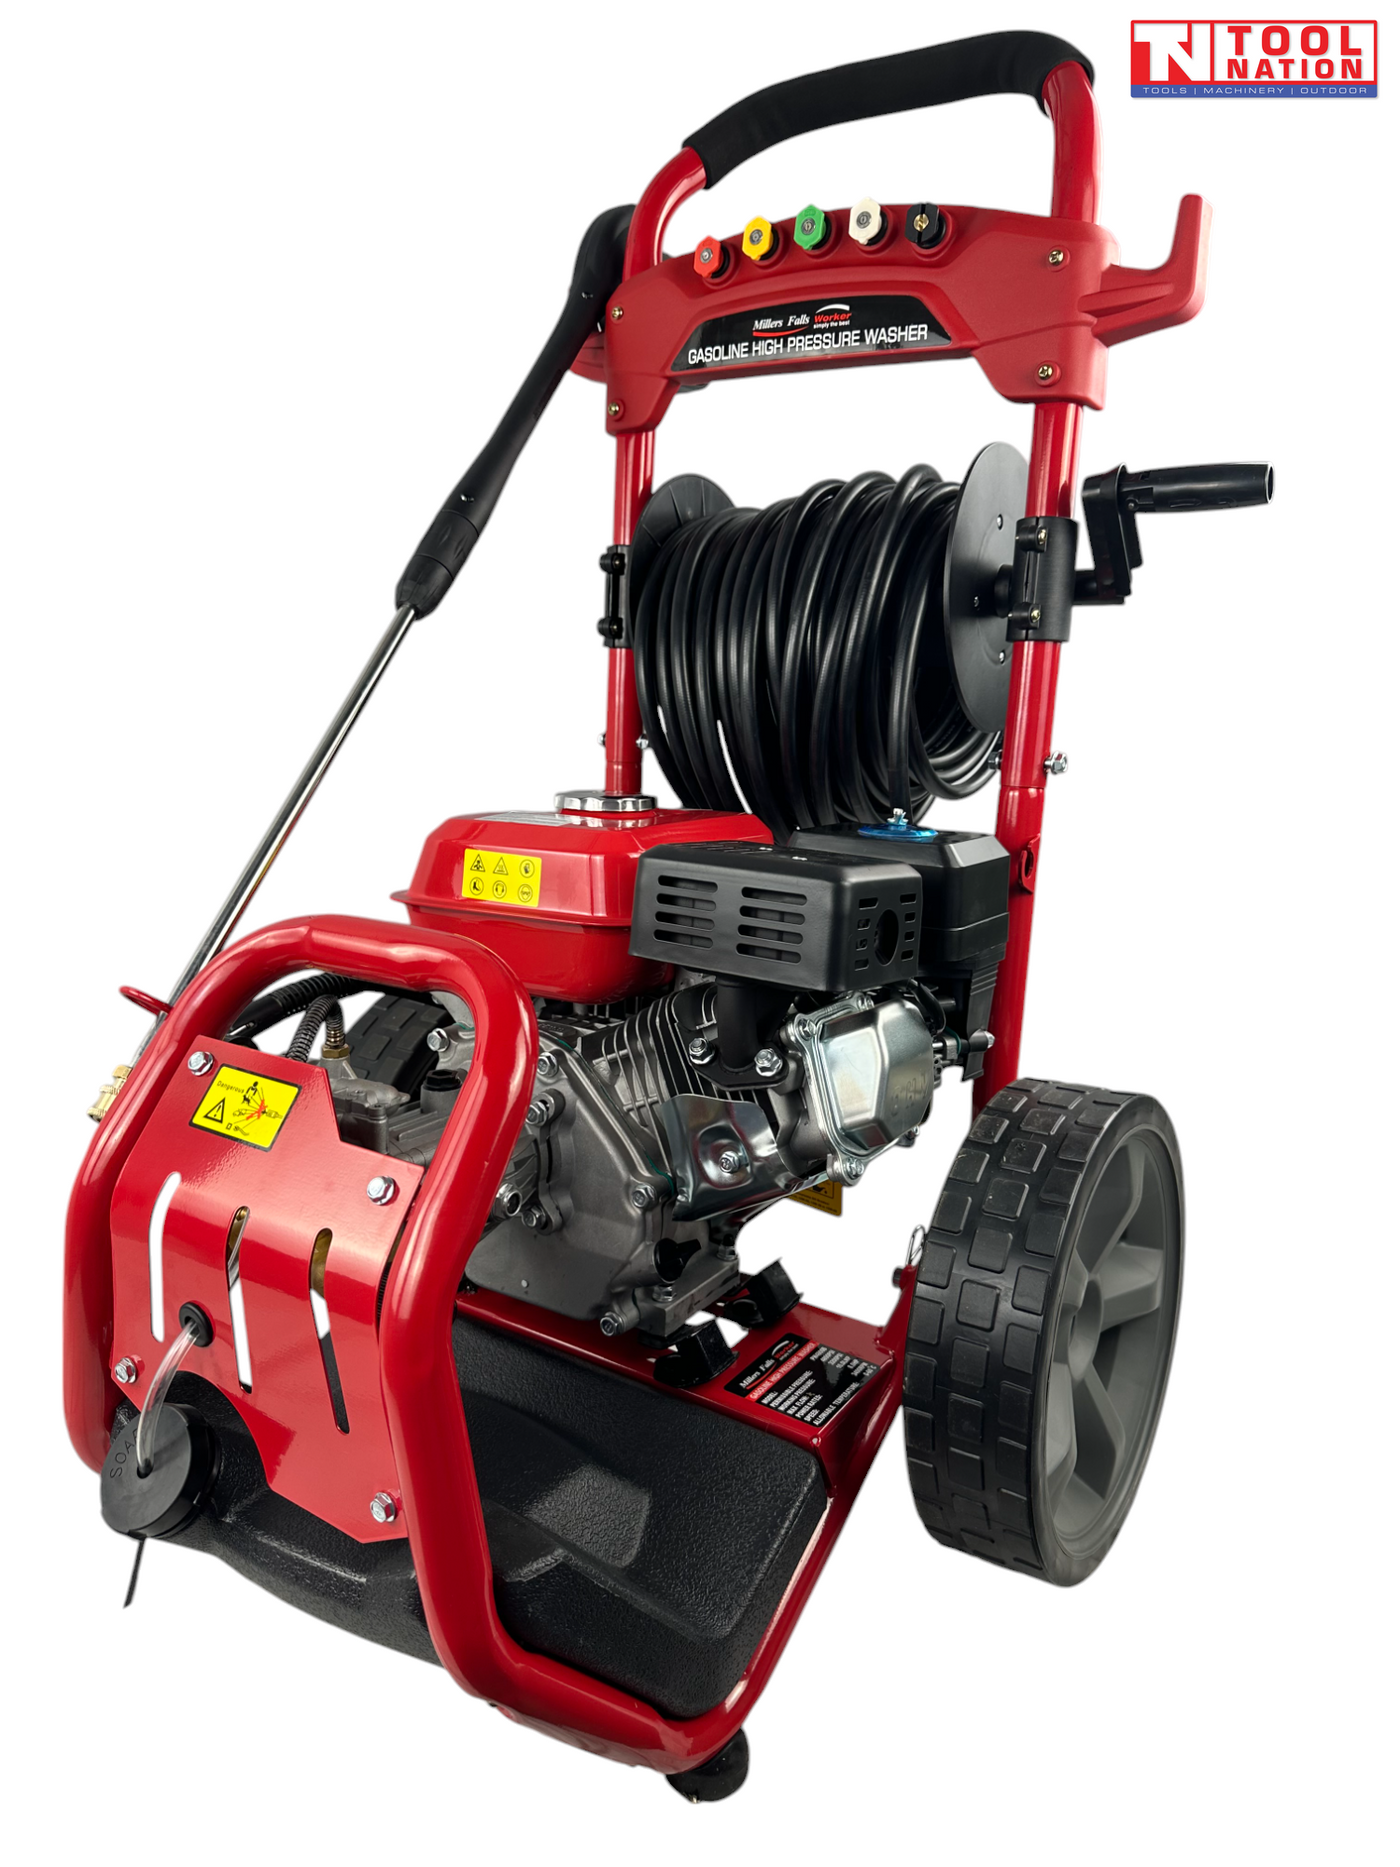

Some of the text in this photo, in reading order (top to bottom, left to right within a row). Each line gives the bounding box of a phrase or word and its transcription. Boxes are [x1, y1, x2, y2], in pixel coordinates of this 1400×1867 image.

[752, 313, 810, 331] Millers Falls
[813, 312, 852, 323] Worker
[813, 322, 829, 330] simply
[688, 324, 928, 365] GASOLINE HIGH PRESSURE WASHER
[216, 1080, 245, 1094] Dangerous
[739, 1358, 775, 1388] Millers Falls
